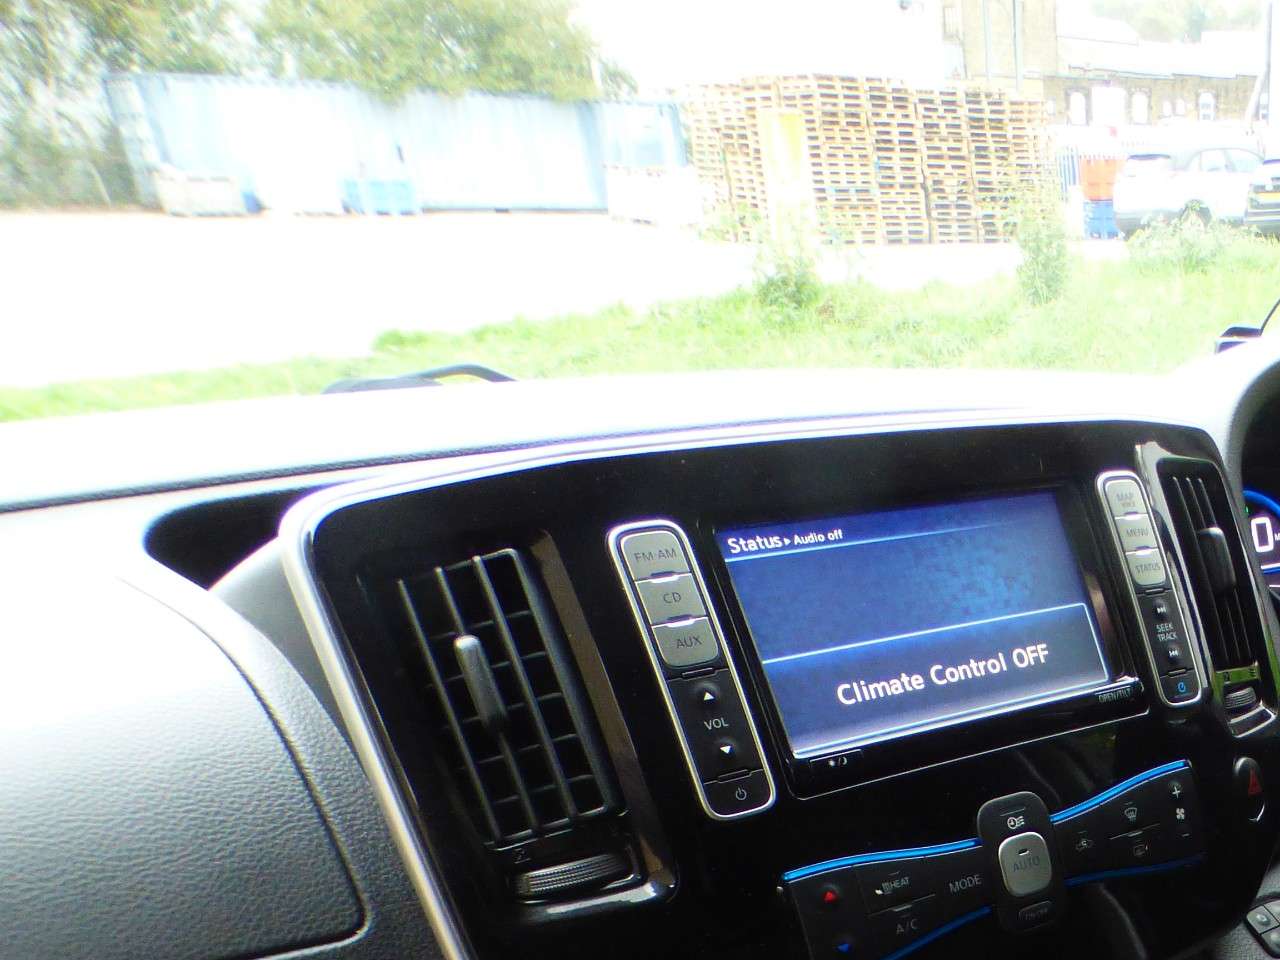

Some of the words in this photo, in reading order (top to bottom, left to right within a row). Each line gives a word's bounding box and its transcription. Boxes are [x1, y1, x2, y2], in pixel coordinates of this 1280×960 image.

[1127, 527, 1149, 537] MENU
[1251, 517, 1274, 553] 0
[727, 534, 783, 554] Status
[794, 532, 825, 545] Audio
[827, 529, 843, 540] off
[663, 592, 682, 604] CD
[1156, 622, 1174, 633] SEEK
[676, 635, 702, 649] AUX
[1157, 631, 1178, 642] TRACK
[836, 673, 925, 705] Climate
[929, 652, 1008, 685] Control
[1012, 643, 1049, 668] OFF
[704, 718, 729, 731] VOL
[1013, 855, 1040, 872] AUTO
[889, 877, 910, 889] HEAT
[949, 875, 983, 893] MODE
[896, 919, 919, 935] A/C
